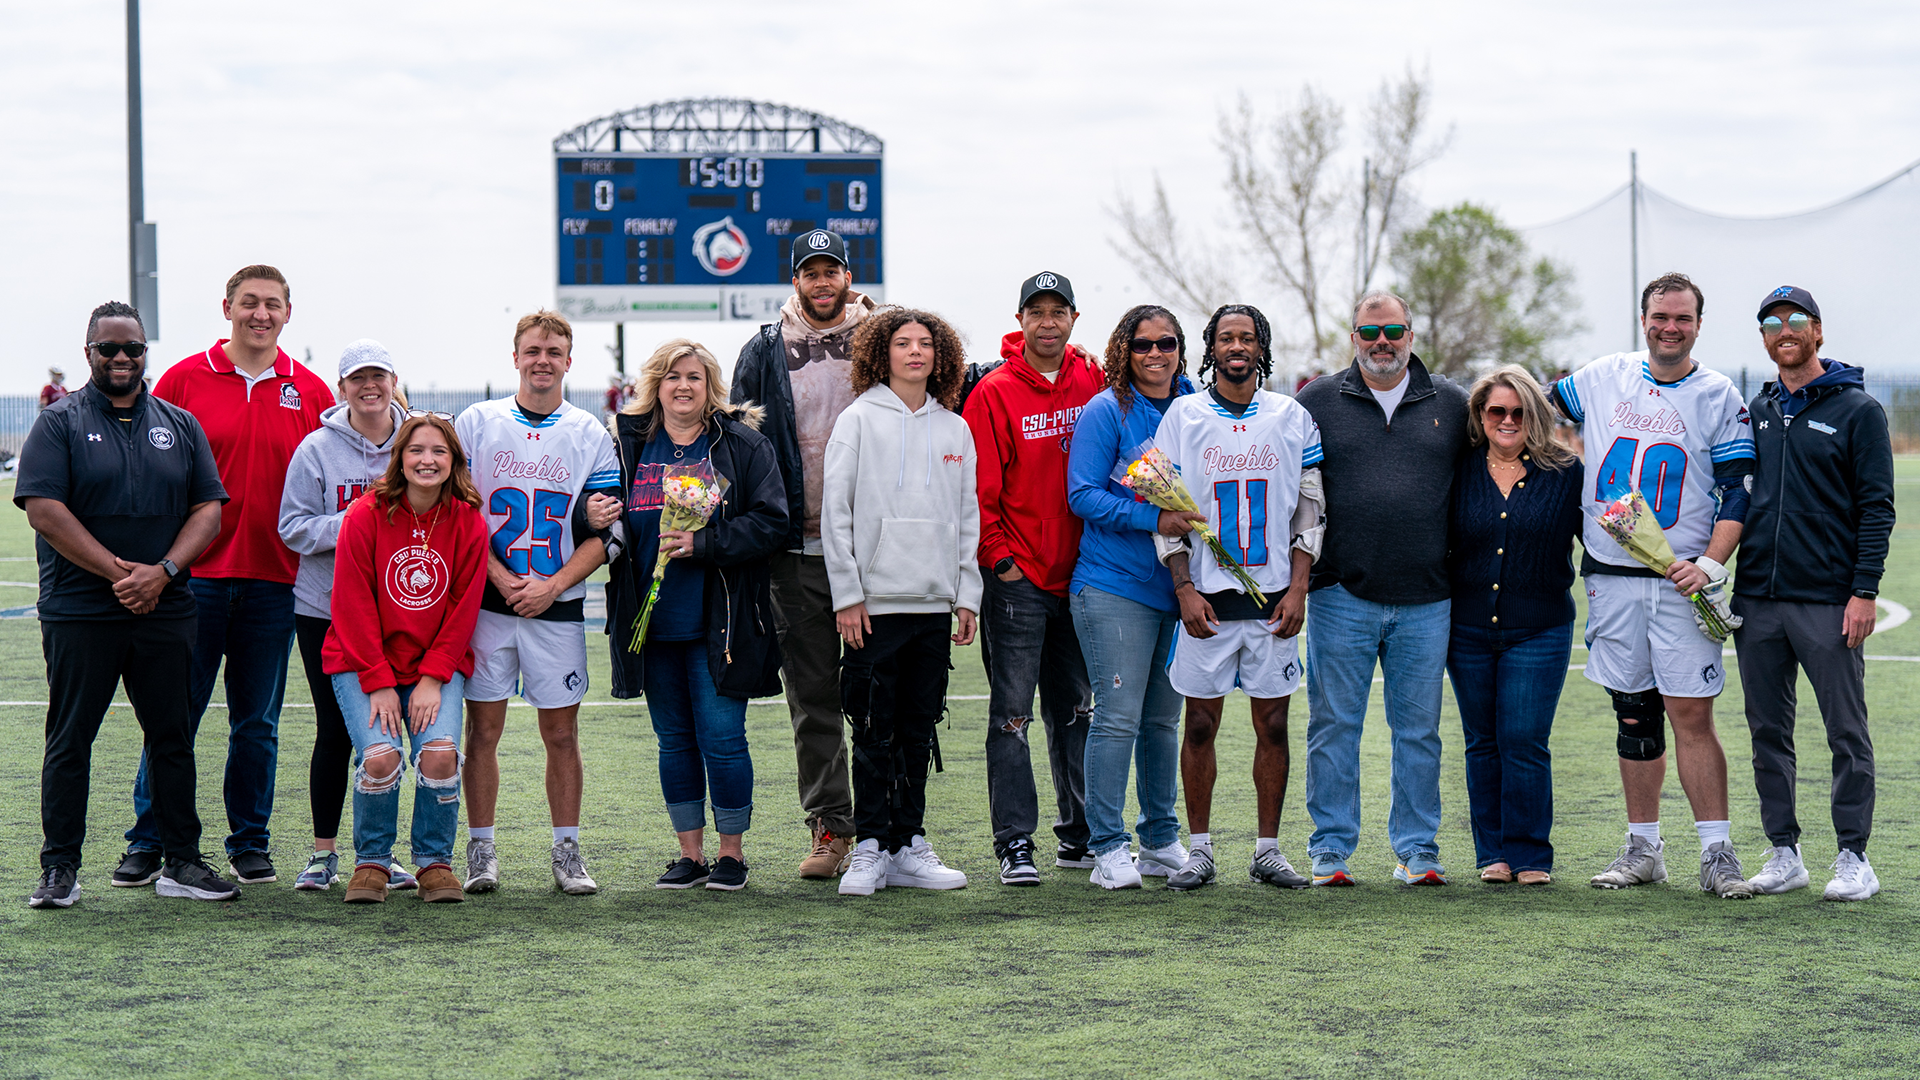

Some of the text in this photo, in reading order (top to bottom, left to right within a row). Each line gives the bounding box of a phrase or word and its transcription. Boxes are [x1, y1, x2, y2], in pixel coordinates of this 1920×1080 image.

[653, 130, 783, 152] STADIUM
[690, 157, 764, 188] 15:00
[595, 180, 614, 211] 0
[848, 180, 868, 212] 0
[624, 218, 678, 235] PENALTY
[827, 218, 879, 235] PENALTY
[1022, 405, 1086, 432] CSU-PUEB
[1608, 402, 1686, 435] Pueblo
[493, 451, 570, 483] Pueblo
[1204, 445, 1279, 475] Pueblo
[1594, 436, 1688, 530] 40
[489, 486, 573, 577] 25
[1214, 478, 1268, 567] 11
[393, 551, 409, 565] CSU
[399, 596, 433, 607] LACROSSE
